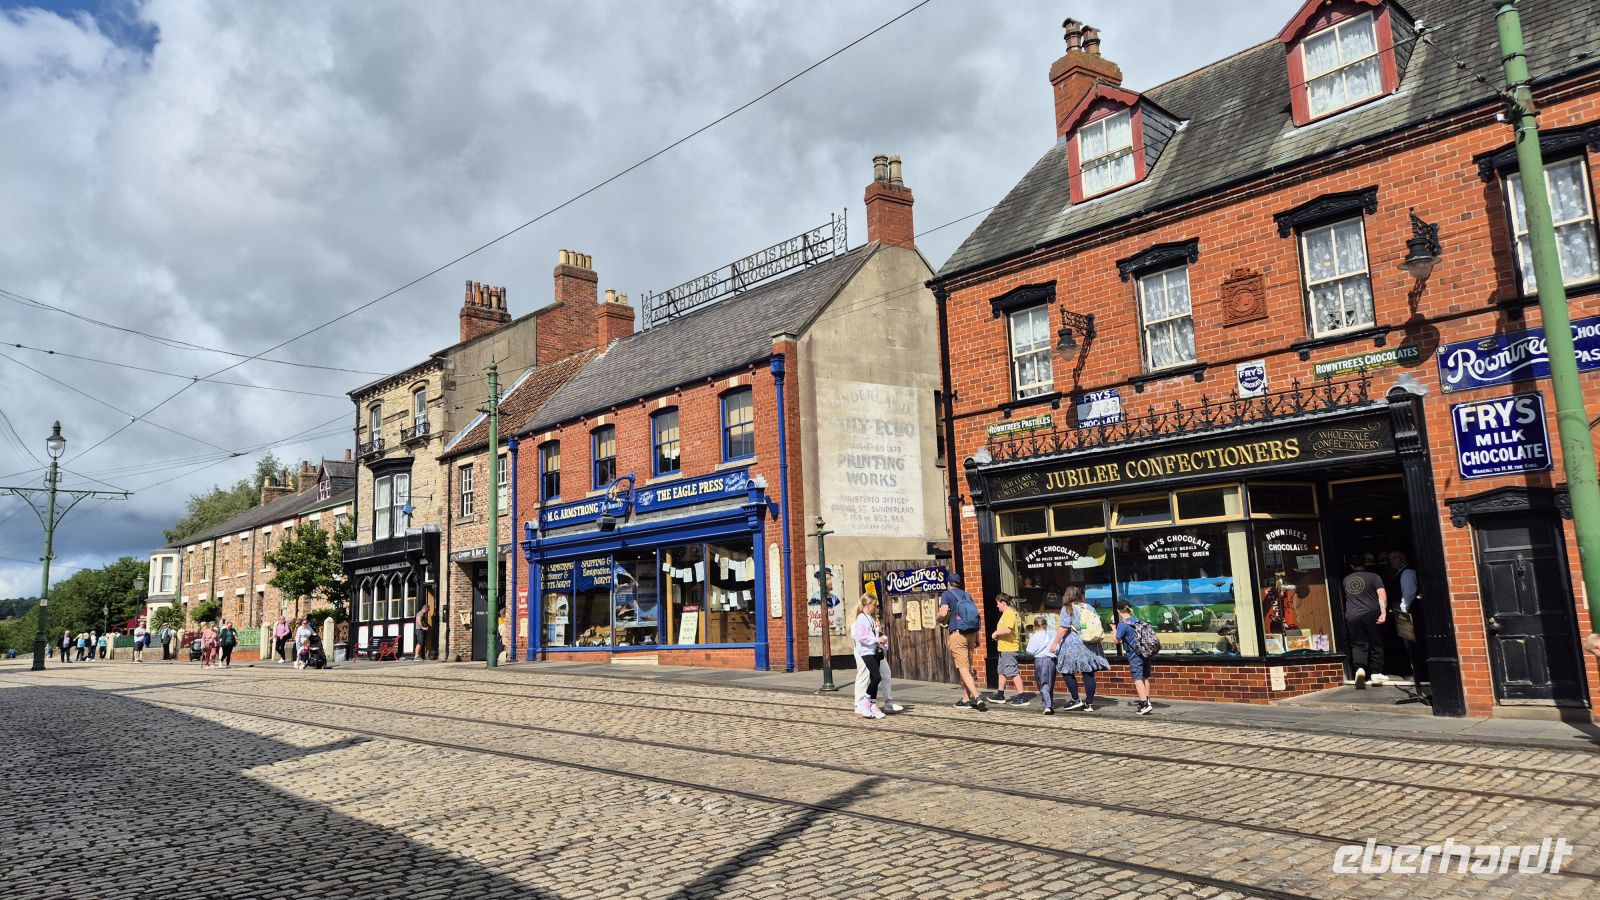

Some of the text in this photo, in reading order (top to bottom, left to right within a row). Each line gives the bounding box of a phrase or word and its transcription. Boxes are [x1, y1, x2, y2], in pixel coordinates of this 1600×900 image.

[1364, 346, 1418, 366] CHOCOLATES
[1021, 416, 1051, 429] PASTILLES
[1459, 398, 1536, 432] FRY'S
[1318, 430, 1370, 441] WHOLESALE
[1475, 429, 1526, 447] MILK
[1312, 440, 1381, 451] CONFECTIONERY
[1461, 443, 1545, 466] CHOCOLATE
[837, 453, 905, 472] PRINTING
[1046, 437, 1301, 490] JUBILEE CONFECTIONERS
[845, 471, 898, 488] WORKS
[656, 488, 671, 501] THE
[672, 483, 698, 499] EAGLE
[698, 477, 724, 494] PRESS
[560, 502, 599, 519] ARMSTRONG
[1145, 534, 1211, 553] FRY'S CHOCOLATE
[1265, 528, 1308, 541] ROWNTREE'S
[1025, 545, 1080, 563] FRY'S CHOCOLATE
[1268, 543, 1308, 551] CHOCOLATES
[581, 558, 605, 568] SHIPPING
[887, 568, 945, 592] Rowntree's
